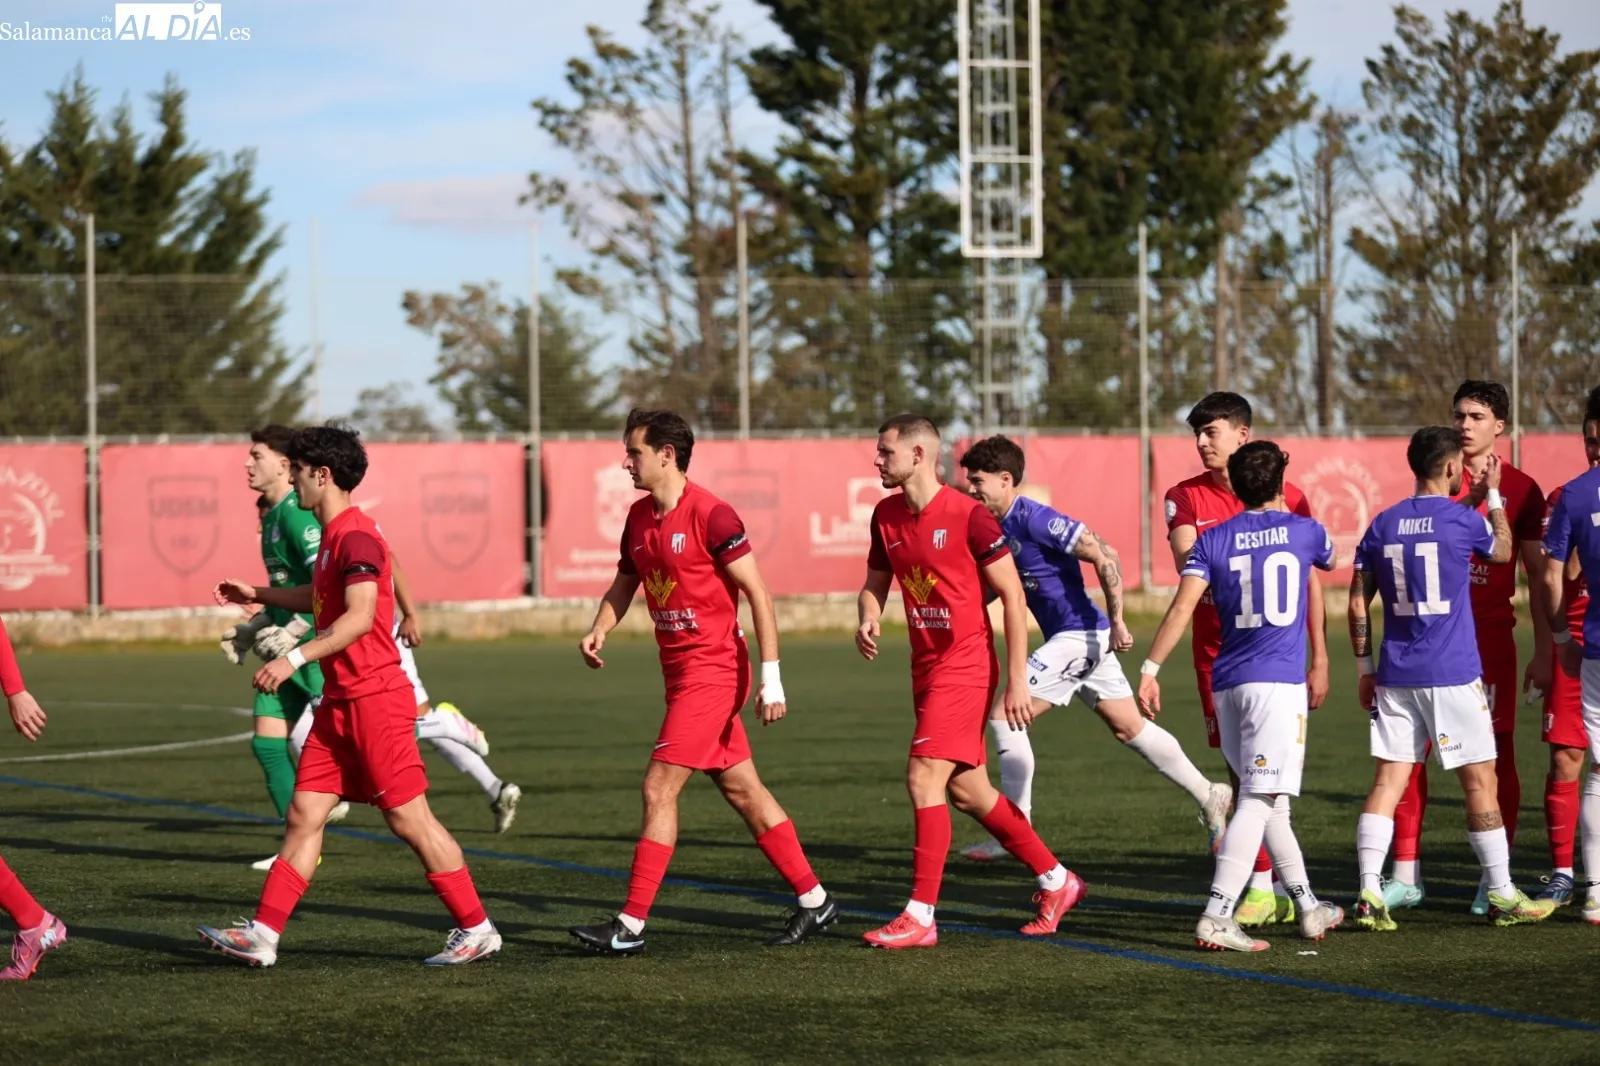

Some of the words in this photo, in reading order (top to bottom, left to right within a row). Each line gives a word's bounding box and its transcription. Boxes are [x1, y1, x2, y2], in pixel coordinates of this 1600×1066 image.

[1235, 526, 1289, 550] CESITAR
[1397, 516, 1434, 535] MIKEL
[1229, 551, 1300, 629] 10
[1383, 542, 1451, 616] 11
